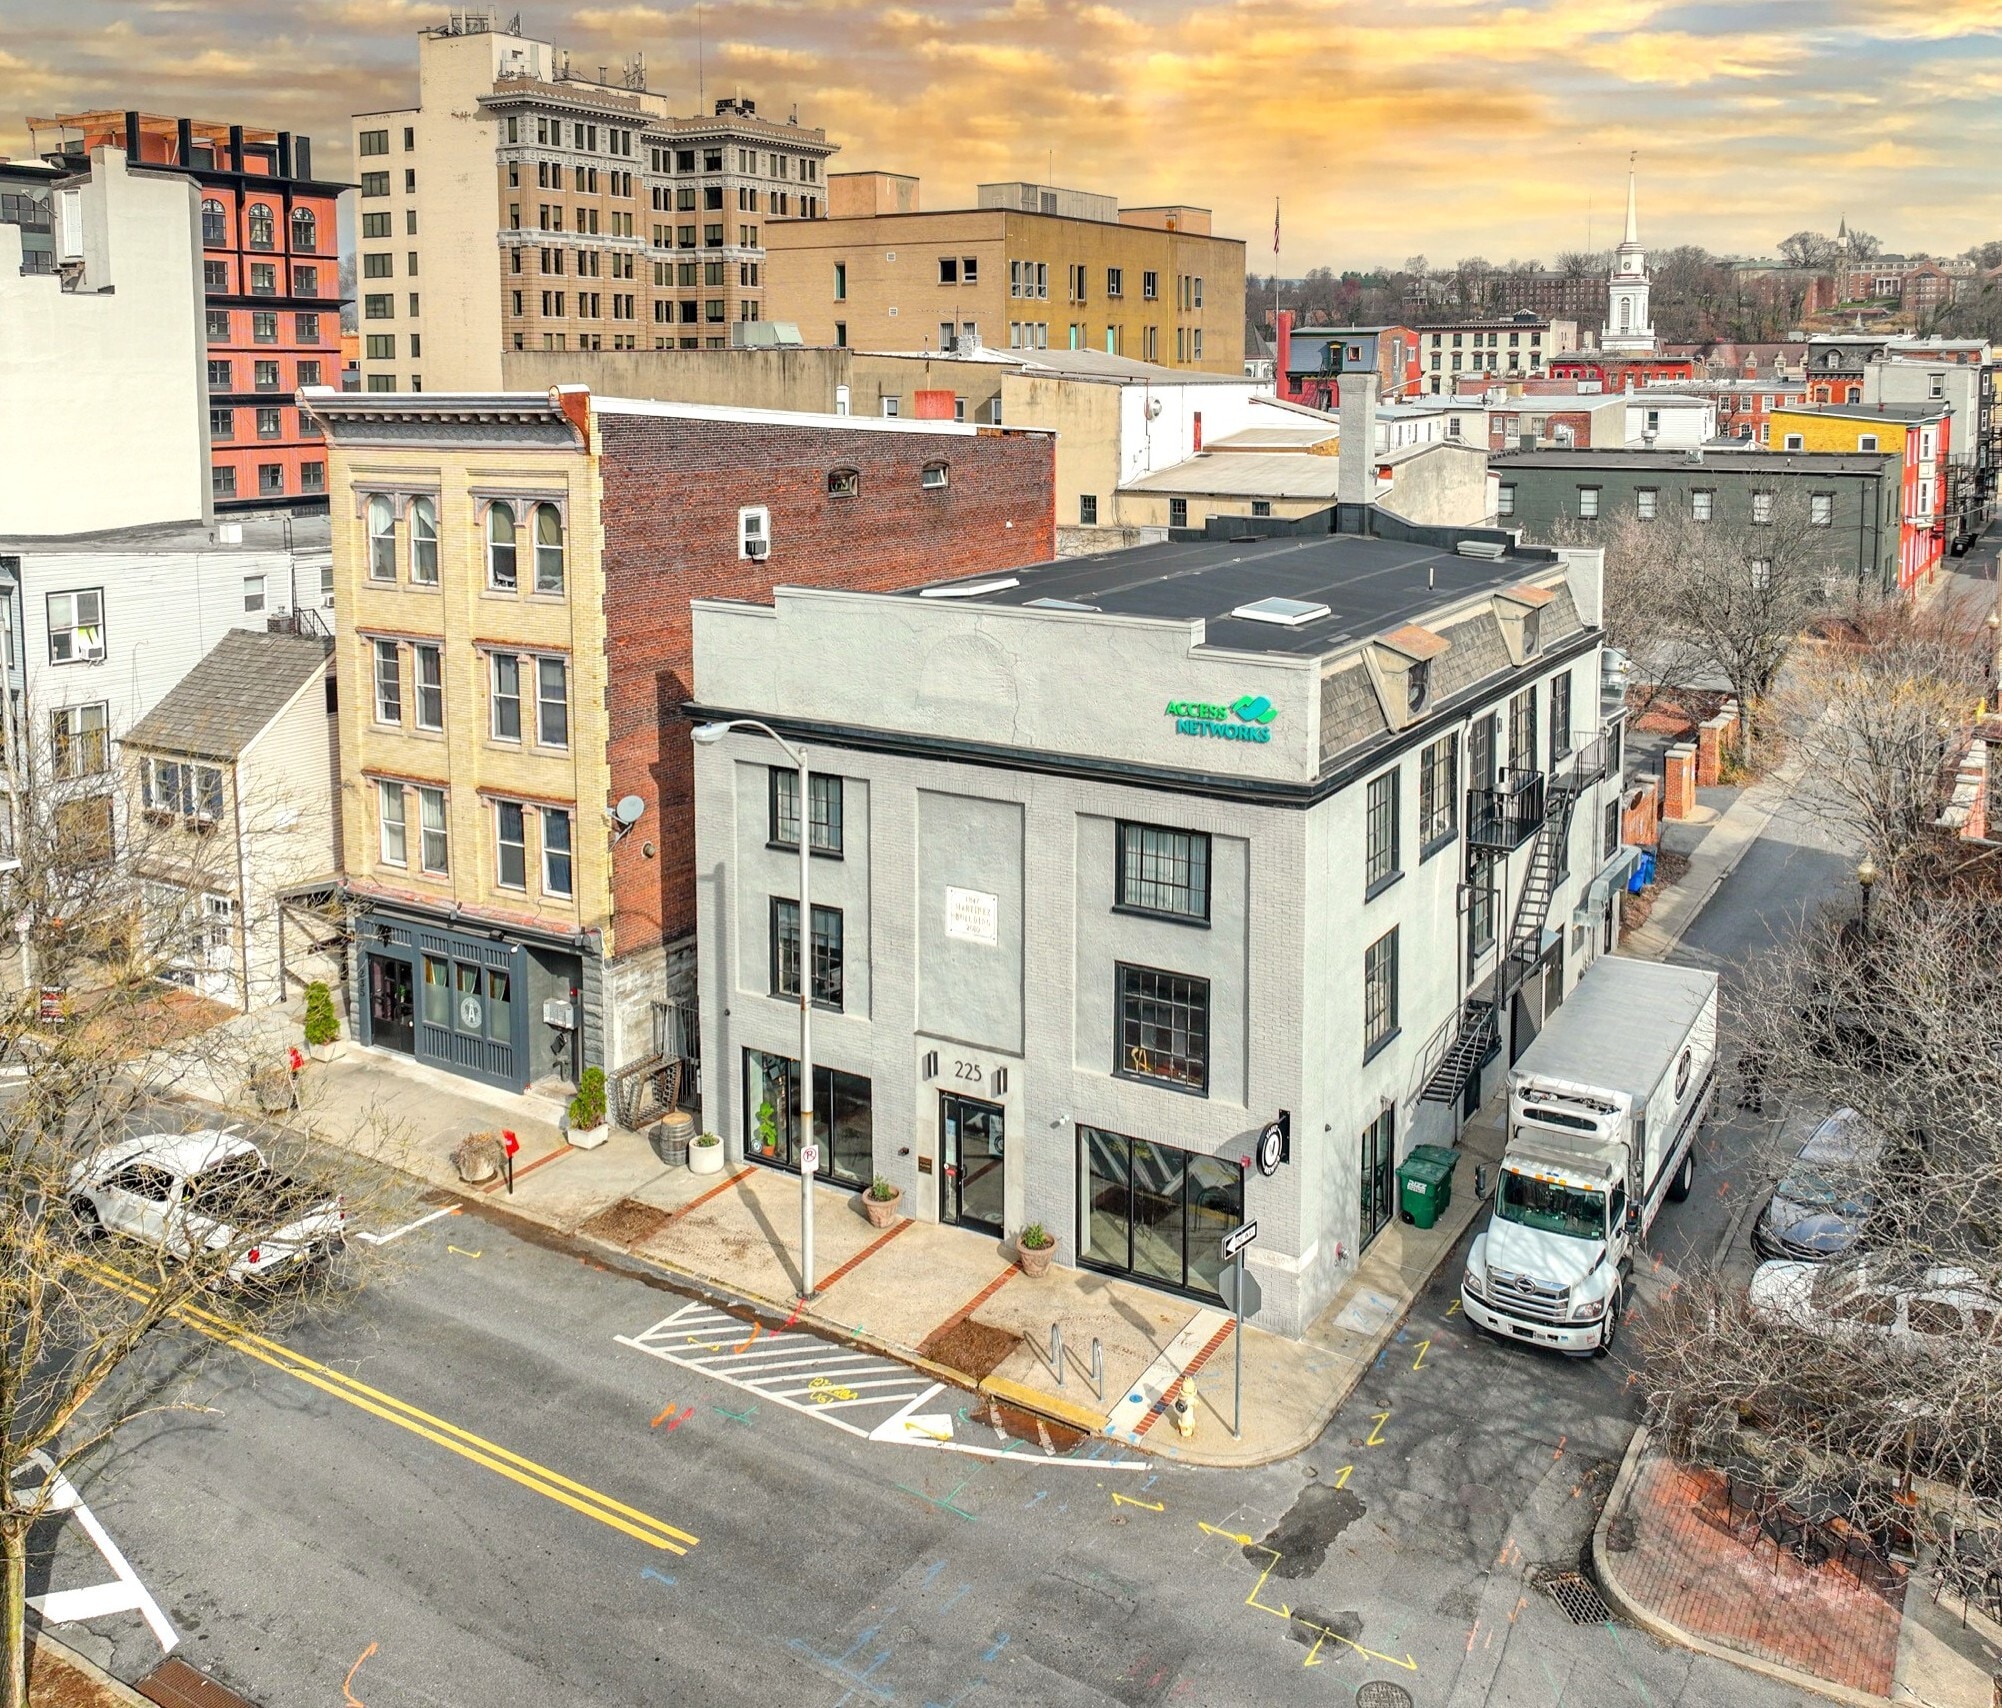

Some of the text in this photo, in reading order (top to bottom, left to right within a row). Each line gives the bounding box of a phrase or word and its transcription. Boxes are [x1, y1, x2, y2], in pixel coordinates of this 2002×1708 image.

[1165, 700, 1228, 721] ACCESS
[1176, 719, 1271, 743] NETWORKS
[955, 1060, 982, 1082] 225
